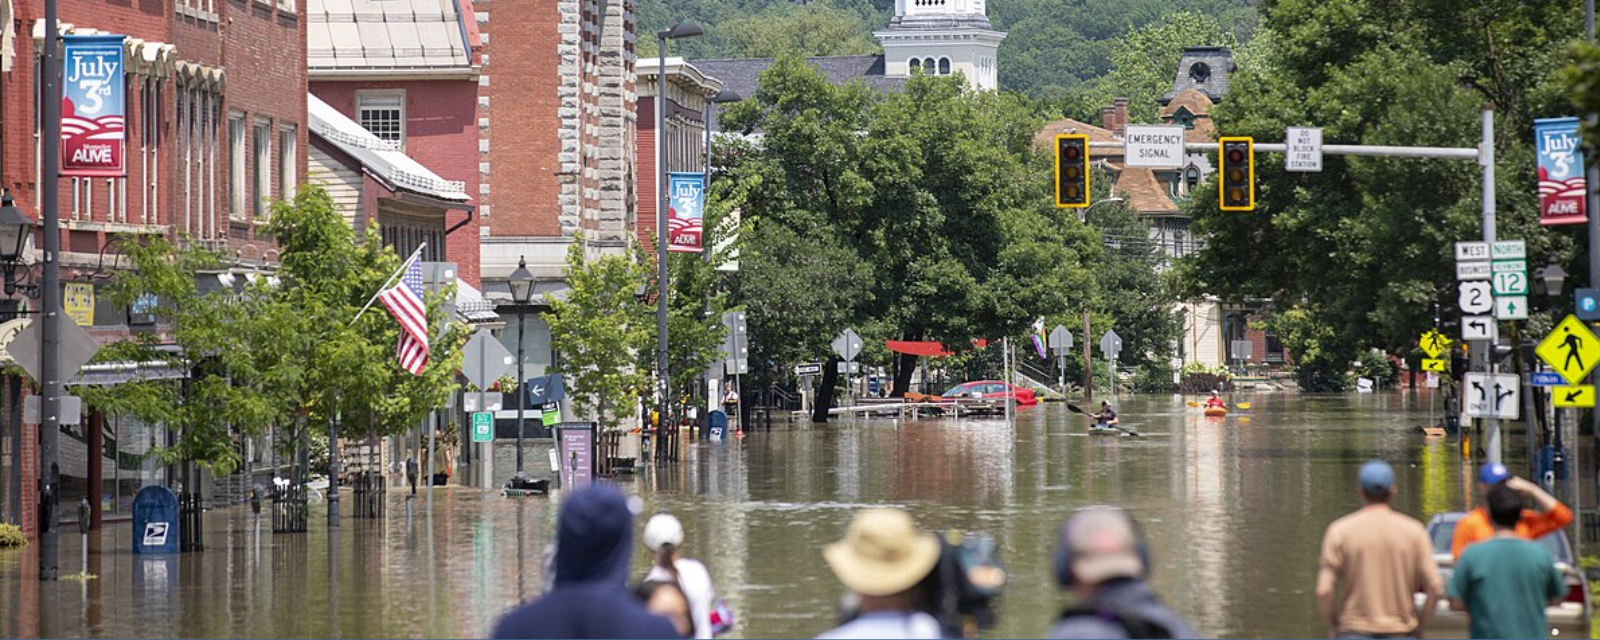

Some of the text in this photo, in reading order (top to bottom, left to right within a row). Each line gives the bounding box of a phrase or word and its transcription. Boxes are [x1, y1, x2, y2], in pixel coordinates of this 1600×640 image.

[68, 56, 118, 84] July
[79, 80, 111, 114] 3rd
[1128, 134, 1181, 144] EMERGENCY
[1542, 133, 1578, 155] July
[72, 149, 112, 163] ALIVE
[1139, 149, 1170, 157] SIGNAL
[673, 183, 700, 201] July
[1547, 202, 1578, 215] ALIVE
[1461, 246, 1484, 256] WEST
[1494, 244, 1522, 254] NORTH
[1460, 265, 1489, 275] BUSINESS
[1499, 273, 1520, 291] 12
[1470, 287, 1482, 306] 2
